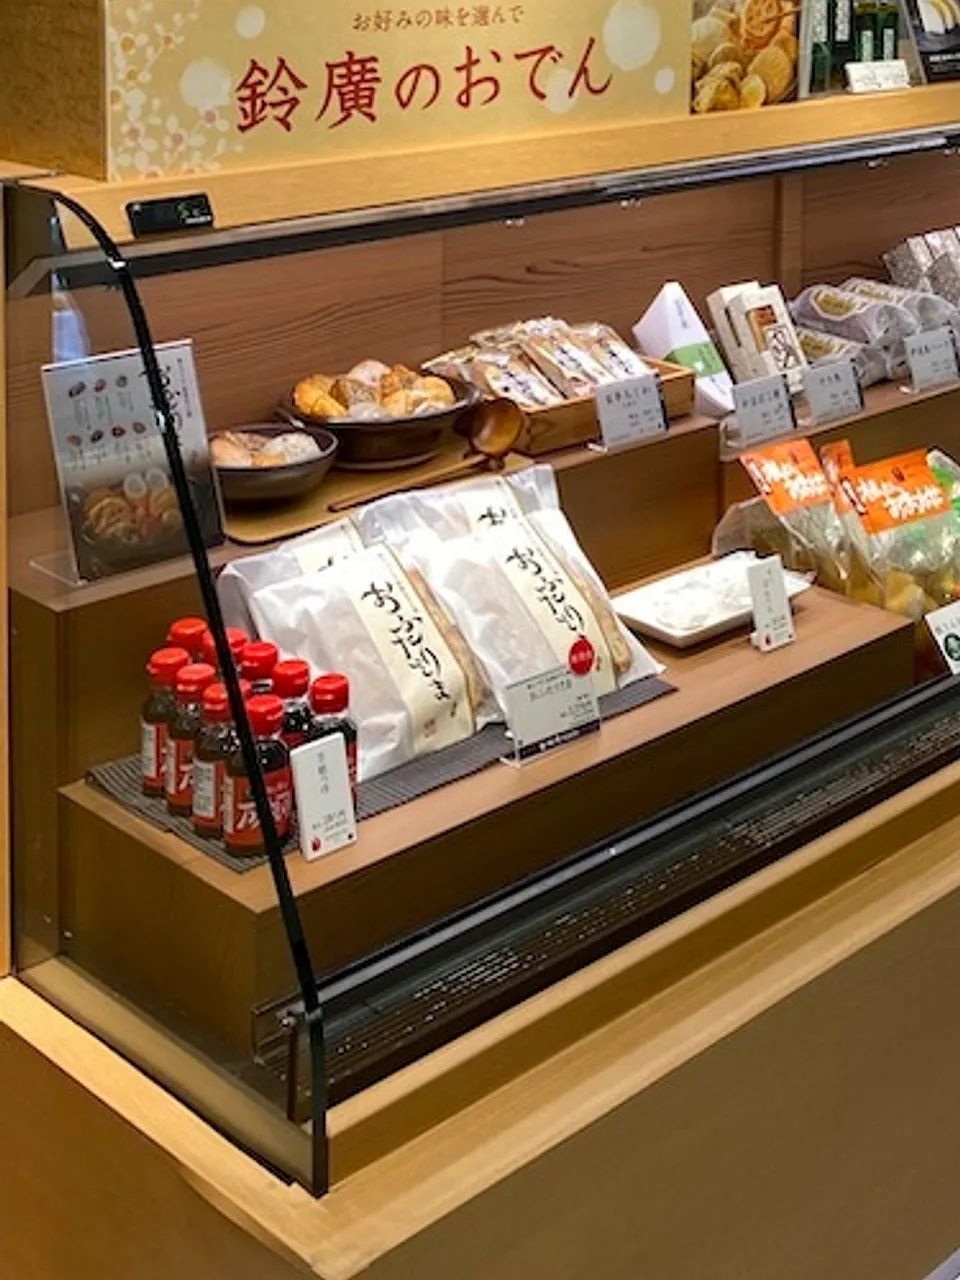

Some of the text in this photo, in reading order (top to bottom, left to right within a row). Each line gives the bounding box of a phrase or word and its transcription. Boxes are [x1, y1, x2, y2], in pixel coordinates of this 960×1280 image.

[353, 5, 524, 32] お好みの味を選んで
[235, 37, 613, 134] 鈴廣のおでん
